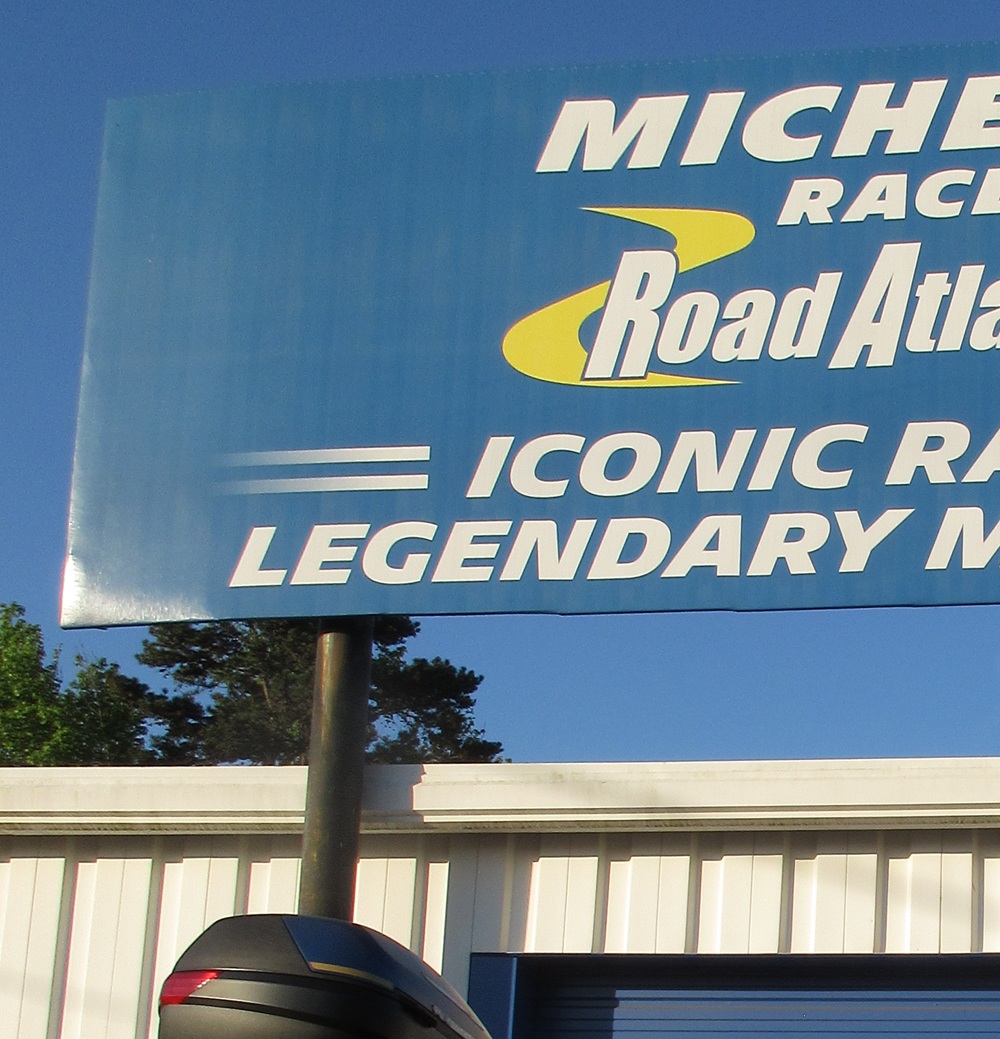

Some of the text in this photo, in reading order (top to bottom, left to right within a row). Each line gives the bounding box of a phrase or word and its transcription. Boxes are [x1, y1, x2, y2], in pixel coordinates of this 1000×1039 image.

[582, 250, 843, 380] Road
[465, 423, 869, 498] ICONIC
[228, 508, 916, 588] LEGENDARY
